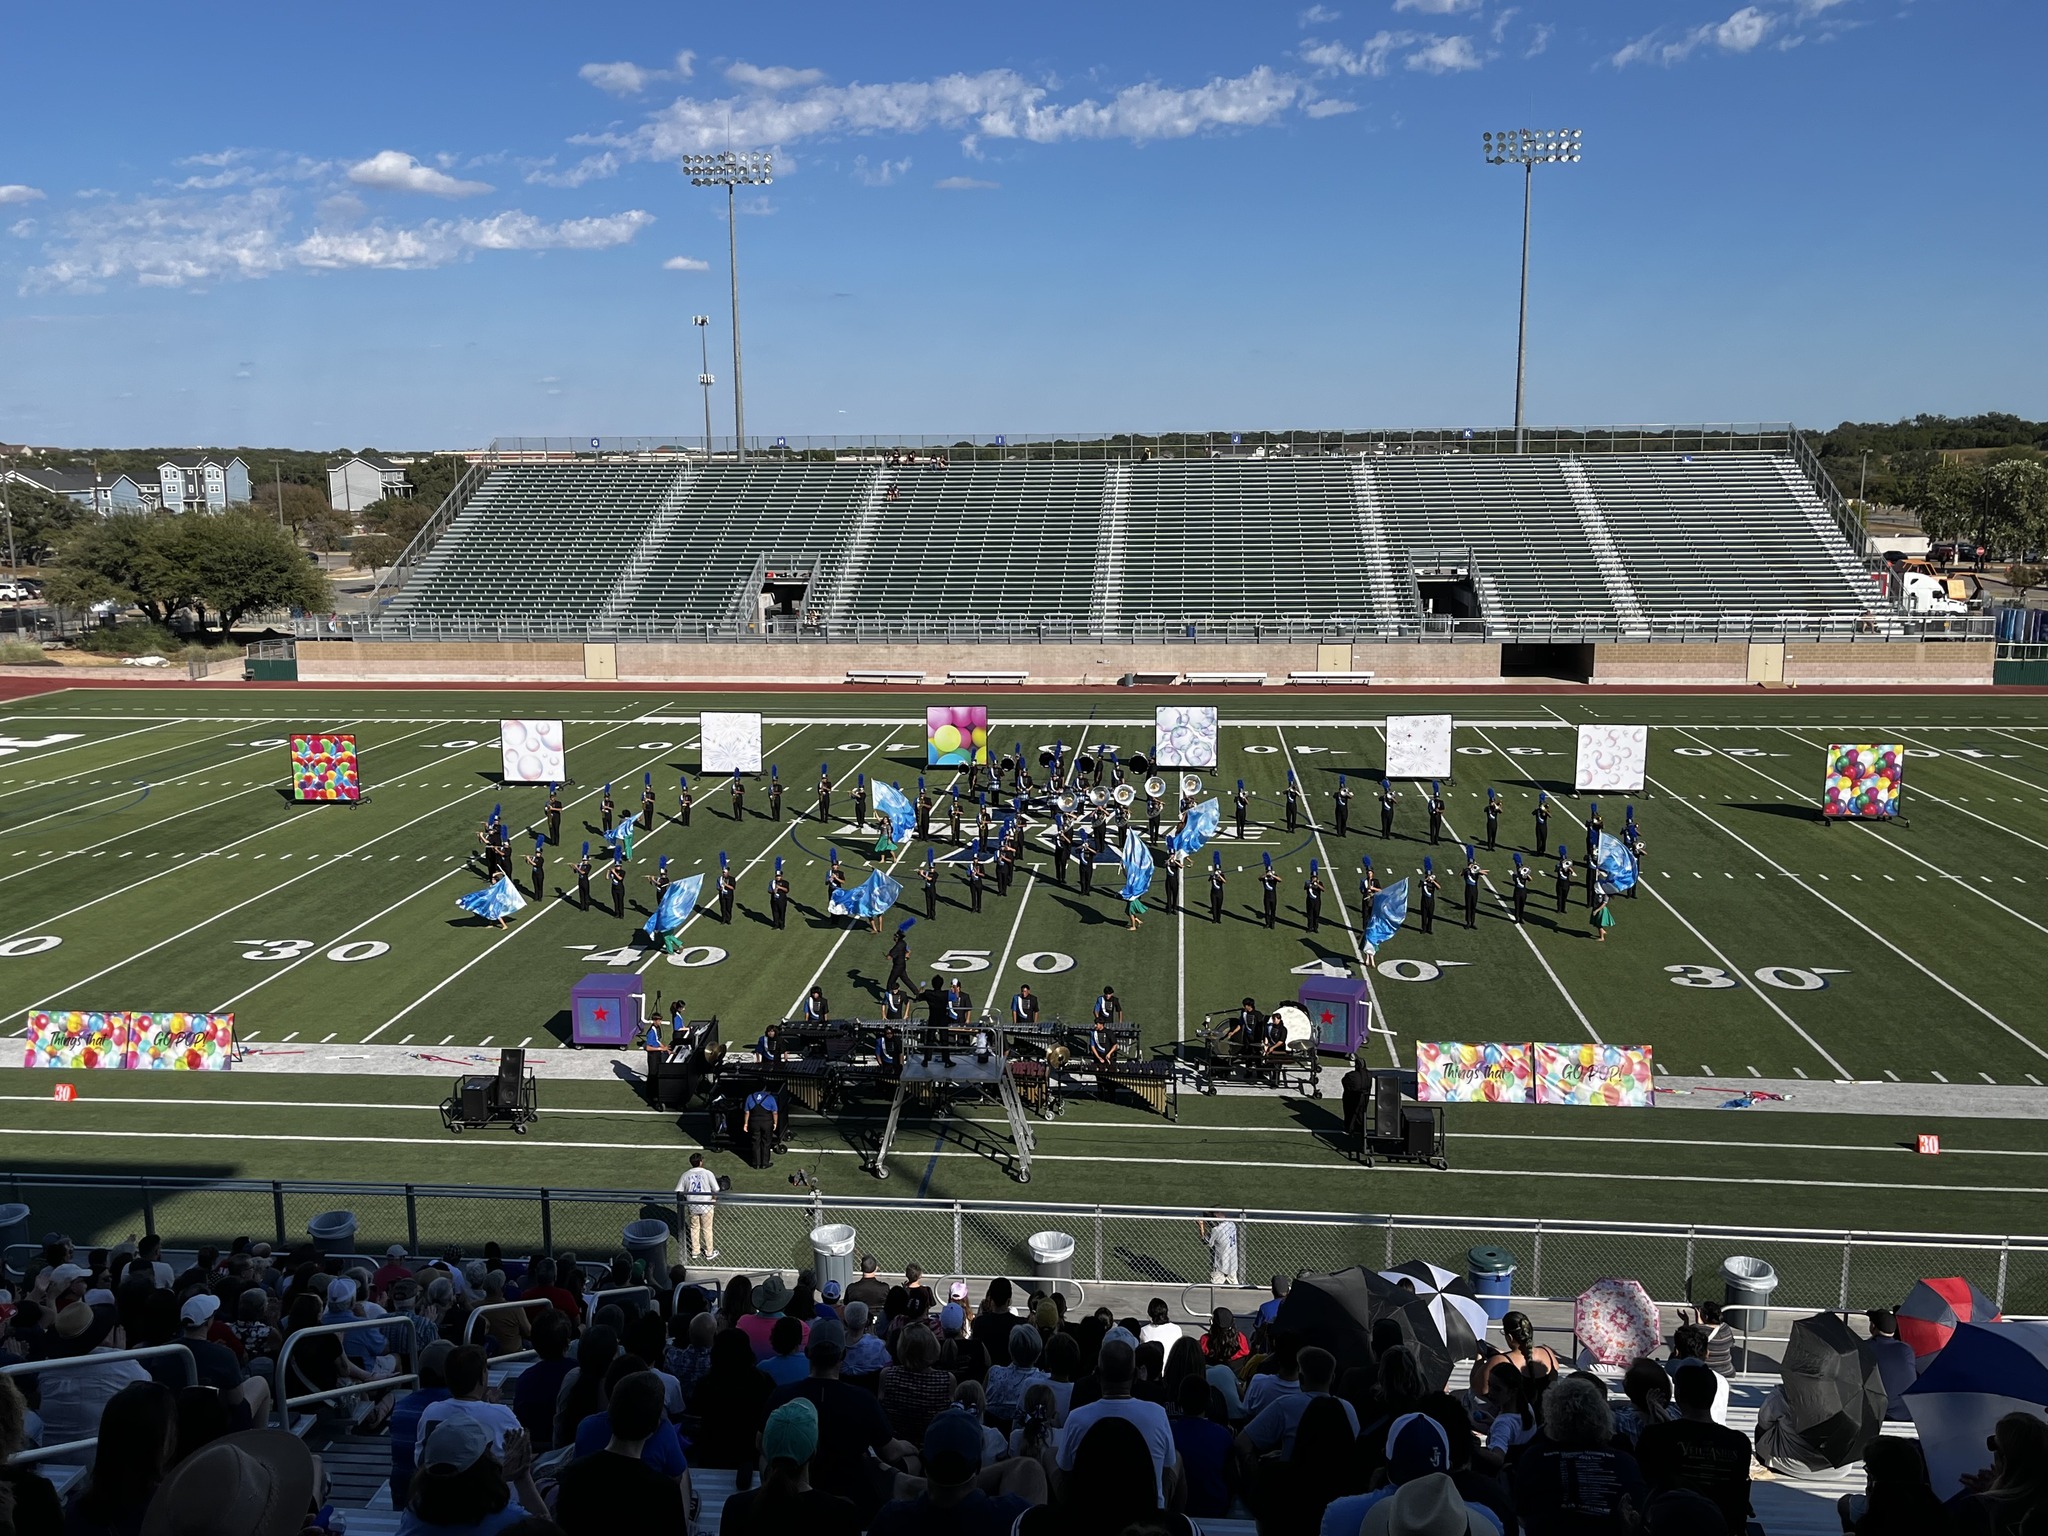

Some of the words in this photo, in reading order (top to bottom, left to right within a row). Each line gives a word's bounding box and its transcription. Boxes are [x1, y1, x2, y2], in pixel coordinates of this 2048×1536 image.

[50, 1031, 82, 1051] Things
[85, 1032, 109, 1047] that
[153, 1031, 172, 1047] GO
[174, 1031, 210, 1048] POP!
[1442, 1062, 1480, 1084] Things
[1483, 1063, 1507, 1080] that
[1562, 1063, 1582, 1080] GO
[1588, 1064, 1625, 1082] POP!
[55, 1085, 70, 1101] 30
[1920, 1135, 1939, 1154] 30
[691, 1181, 702, 1193] 24
